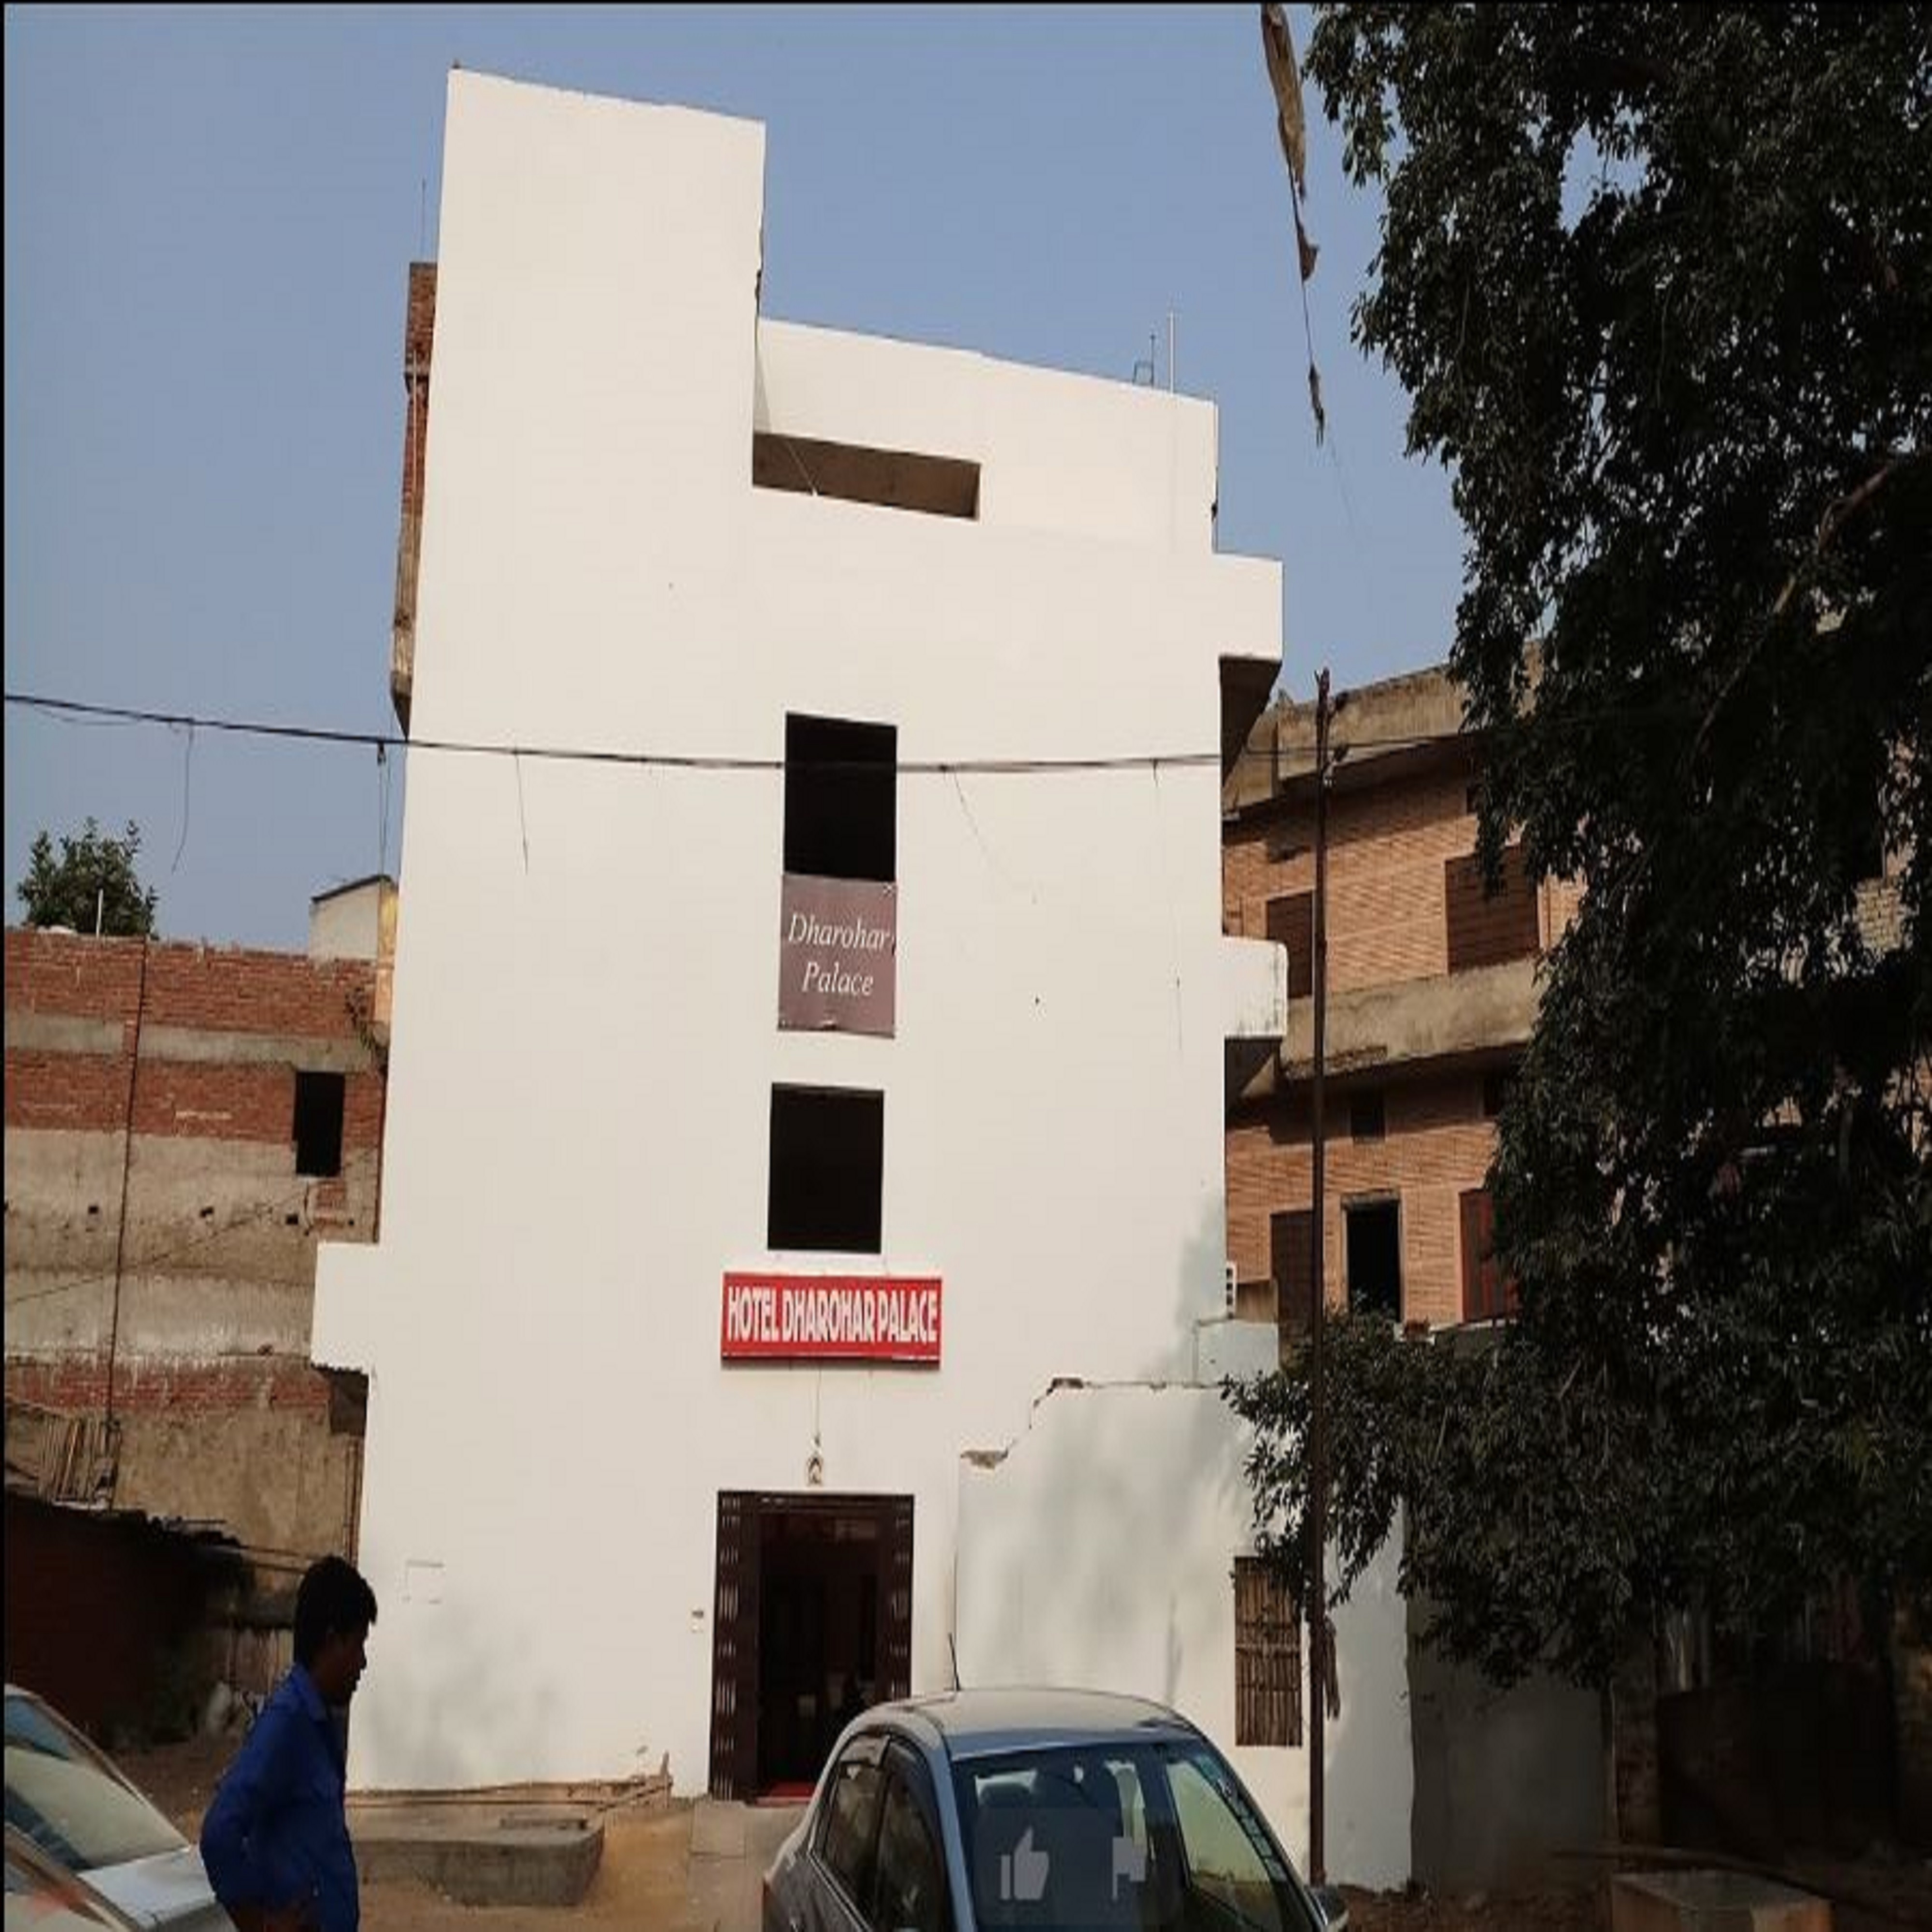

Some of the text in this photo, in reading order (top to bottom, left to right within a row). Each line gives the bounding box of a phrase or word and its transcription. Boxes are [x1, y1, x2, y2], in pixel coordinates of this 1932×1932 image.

[788, 913, 891, 951] Dharohar
[802, 961, 874, 996] Palace
[727, 1286, 937, 1344] HOTEL DHAROHAR PALACE
